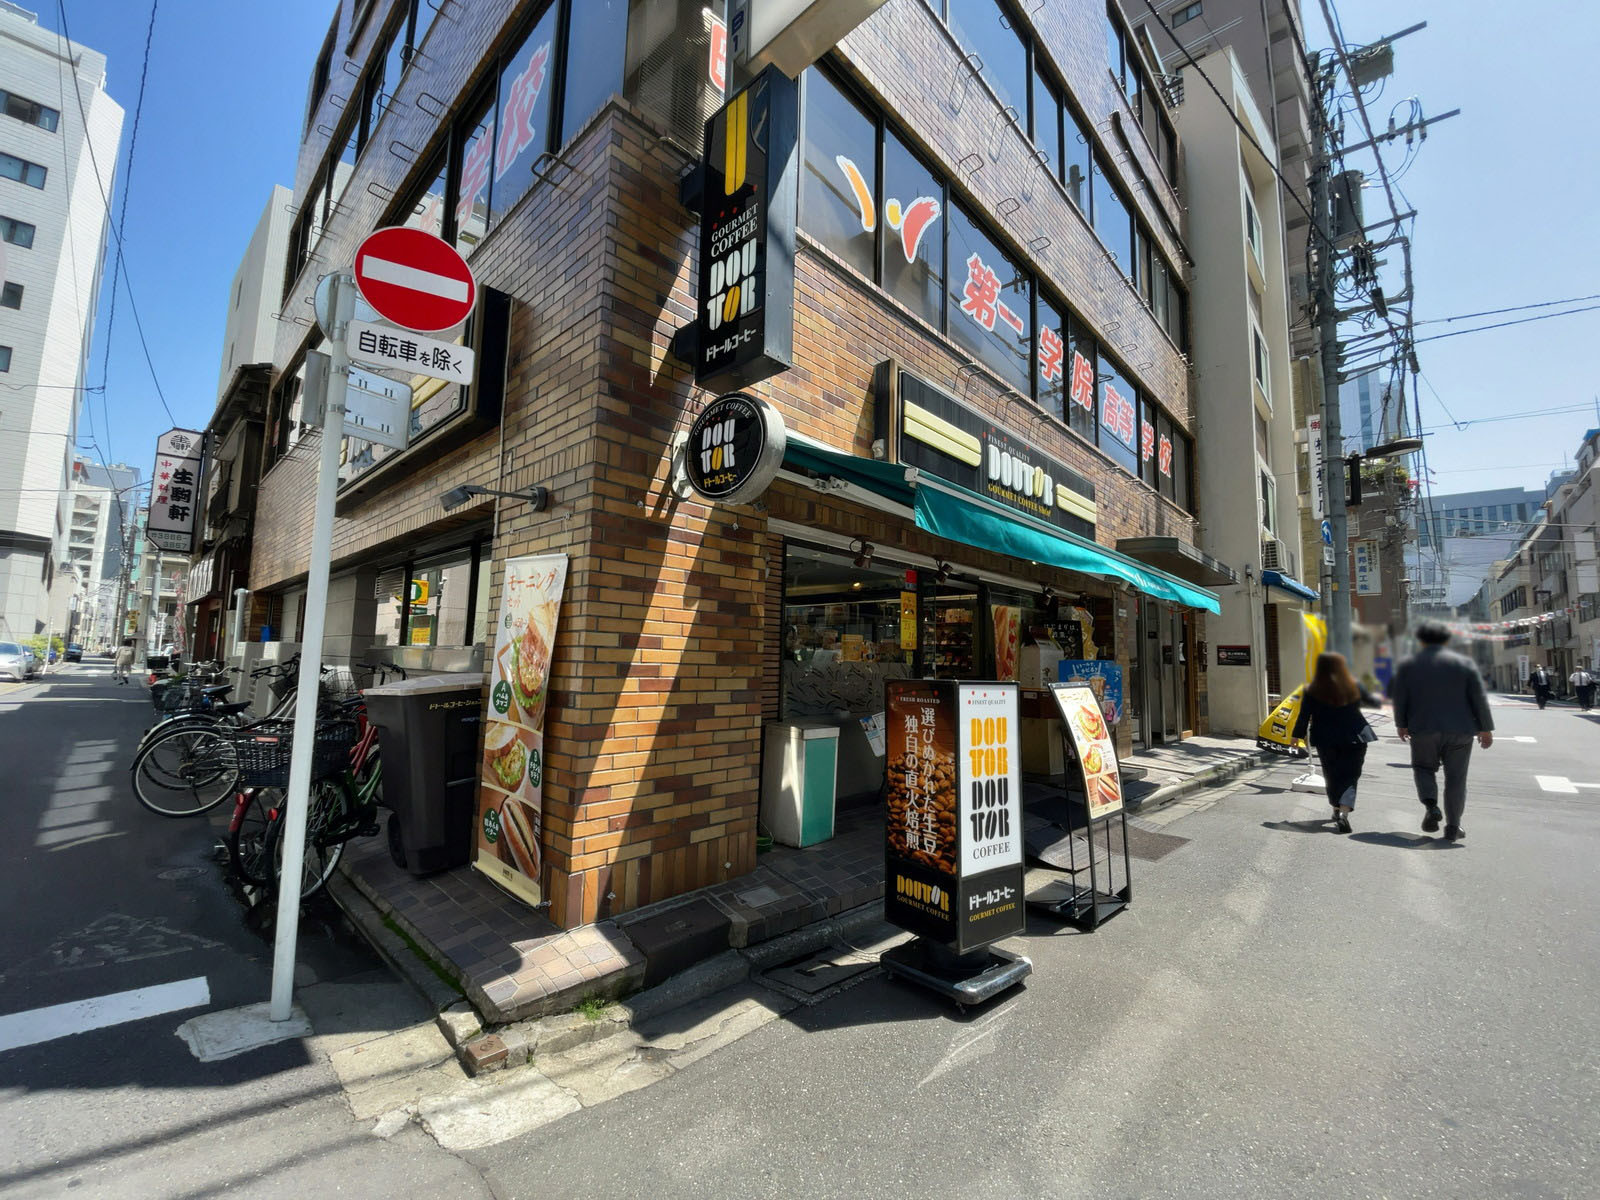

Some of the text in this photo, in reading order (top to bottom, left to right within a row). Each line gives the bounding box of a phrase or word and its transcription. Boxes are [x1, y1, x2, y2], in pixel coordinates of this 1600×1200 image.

[711, 202, 758, 243] GOURMET
[711, 216, 758, 257] COFFEE
[710, 237, 757, 297] DOU
[707, 275, 755, 331] TOR
[358, 329, 464, 375] 自転車を除く
[706, 328, 757, 363] ドトールコーヒー
[694, 402, 753, 436] GOURMET COFFEE
[702, 418, 735, 450] DOU
[700, 443, 736, 474] TOR
[988, 434, 1030, 463] FINEST QUALITY
[156, 460, 173, 505] 中華料理
[704, 472, 737, 488] ドトールコーヒー
[988, 444, 1053, 506] DOUTOR
[168, 468, 194, 522] 生駒軒
[988, 483, 1017, 502] GOURMET
[1018, 495, 1038, 512] COFFEE
[508, 567, 558, 592] モーニング
[971, 716, 1008, 747] DOU
[969, 747, 1008, 778] TOR
[904, 714, 920, 850] 独自の直火焙煎
[920, 707, 938, 857] 選びぬかれた生豆
[971, 777, 1009, 811] DOU
[970, 808, 1010, 843] TOR
[973, 841, 1011, 860] COFFEE
[896, 894, 950, 922] GOURMET COFFEE
[897, 874, 950, 912] DOUTOR
[969, 886, 1016, 911] ドトールコーヒー
[969, 902, 1016, 922] GOURMET COFFEE
